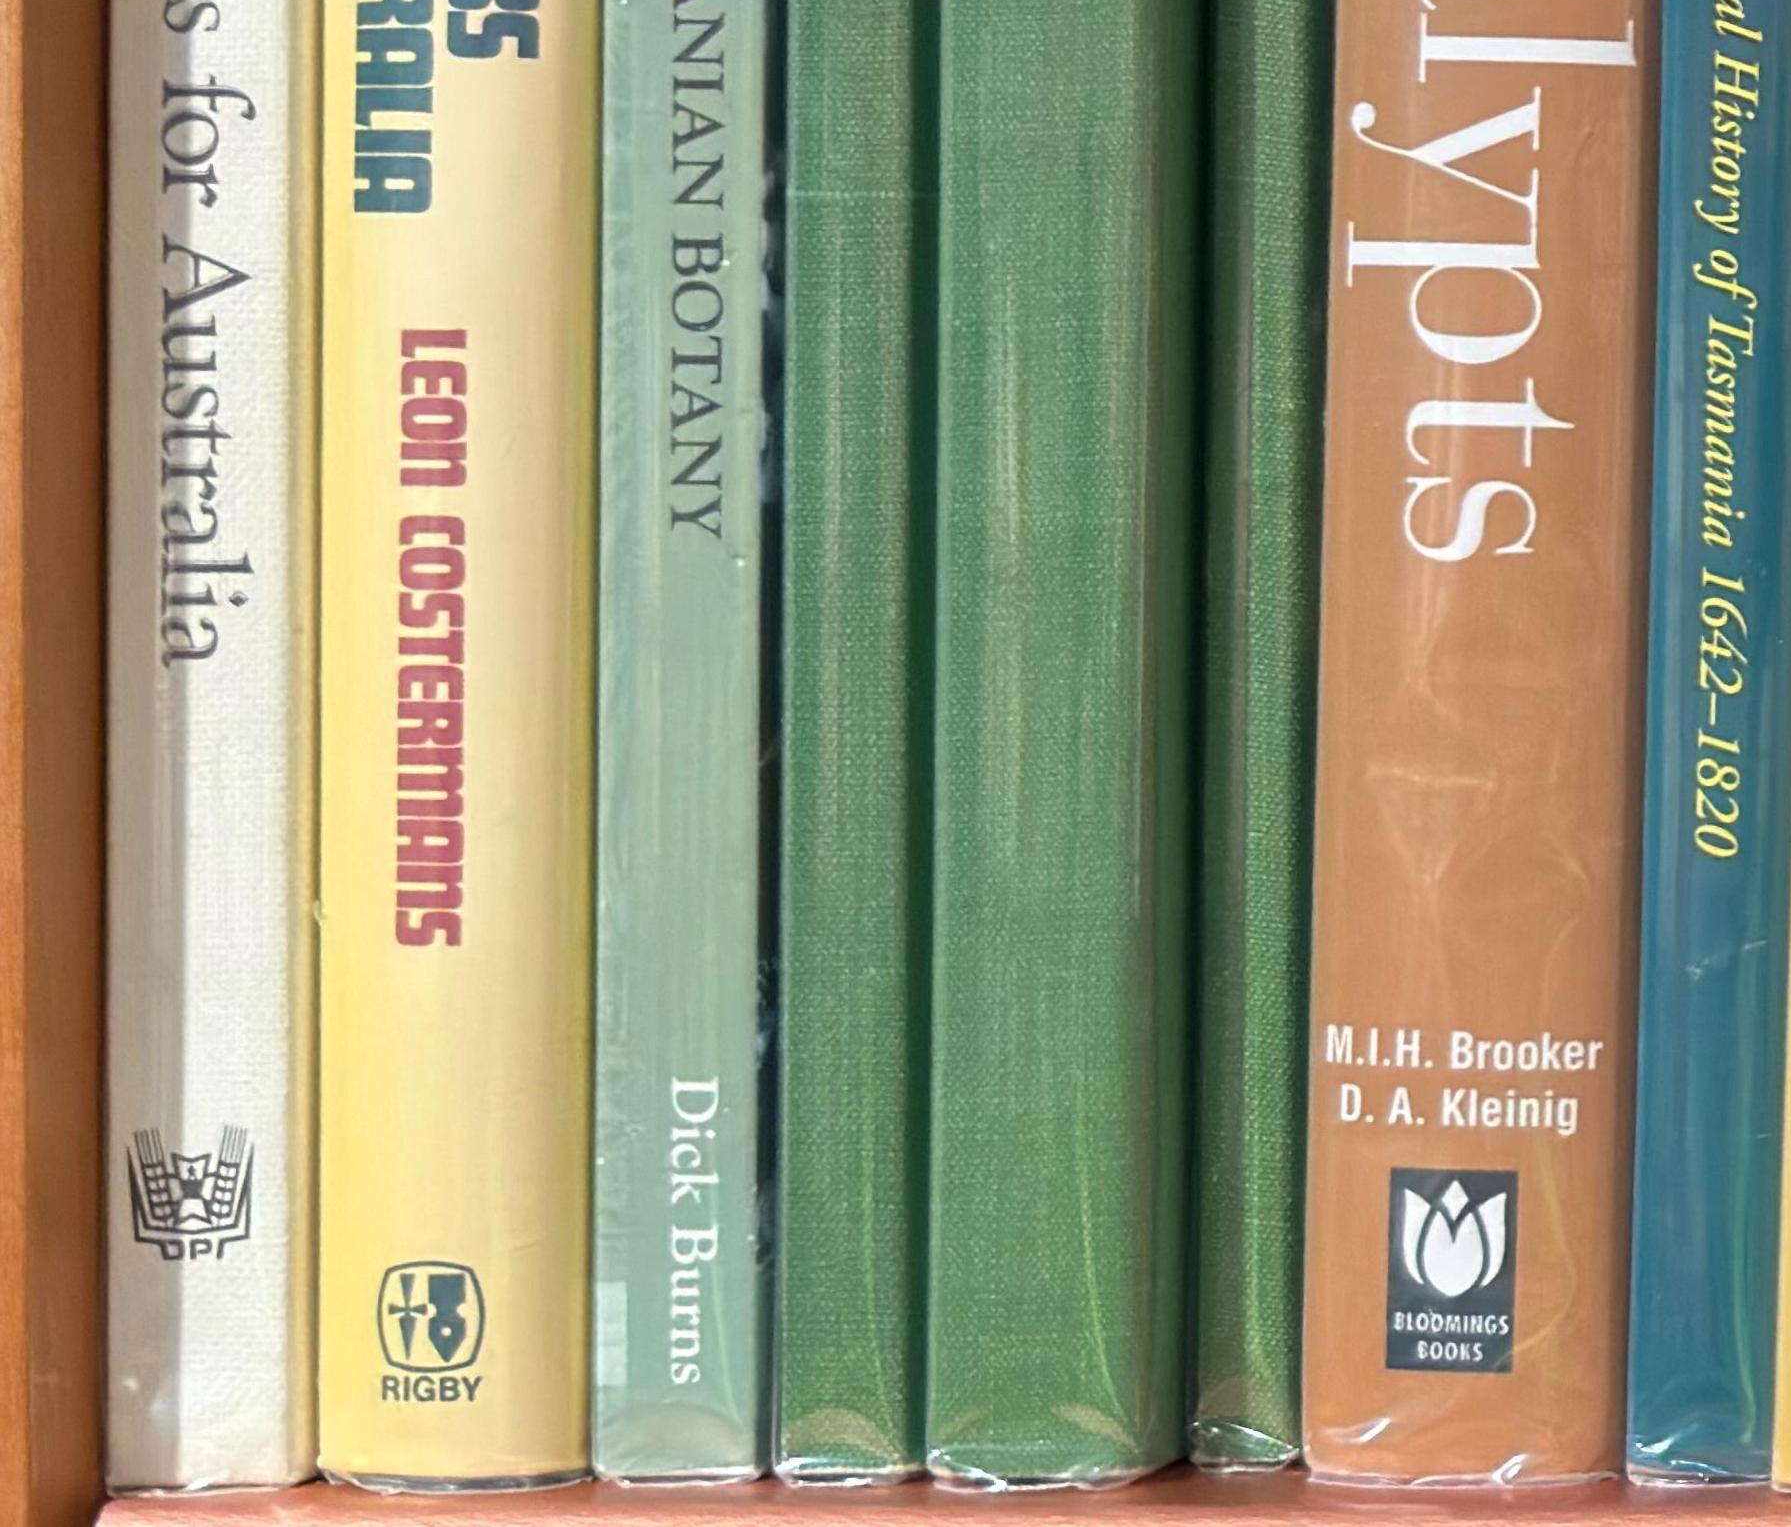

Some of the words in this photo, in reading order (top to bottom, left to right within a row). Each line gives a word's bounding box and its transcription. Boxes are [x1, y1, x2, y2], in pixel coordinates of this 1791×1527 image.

[160, 73, 257, 207] for
[1694, 50, 1761, 235] History
[1693, 249, 1759, 311] of
[160, 233, 253, 668] Australia
[399, 329, 469, 486] LEON
[669, 233, 725, 539] BOTANY
[1701, 314, 1754, 549] Tasmania
[395, 514, 467, 948] COSTERMANS
[1325, 1024, 1435, 1070] M.I.H.
[1448, 1029, 1604, 1072] Brooker
[669, 1075, 720, 1205] Dick
[667, 1228, 719, 1386] Burns
[1395, 1311, 1511, 1336] BLOOMINGS
[1419, 1338, 1484, 1363] BOOKS
[379, 1374, 484, 1403] RIGBY
